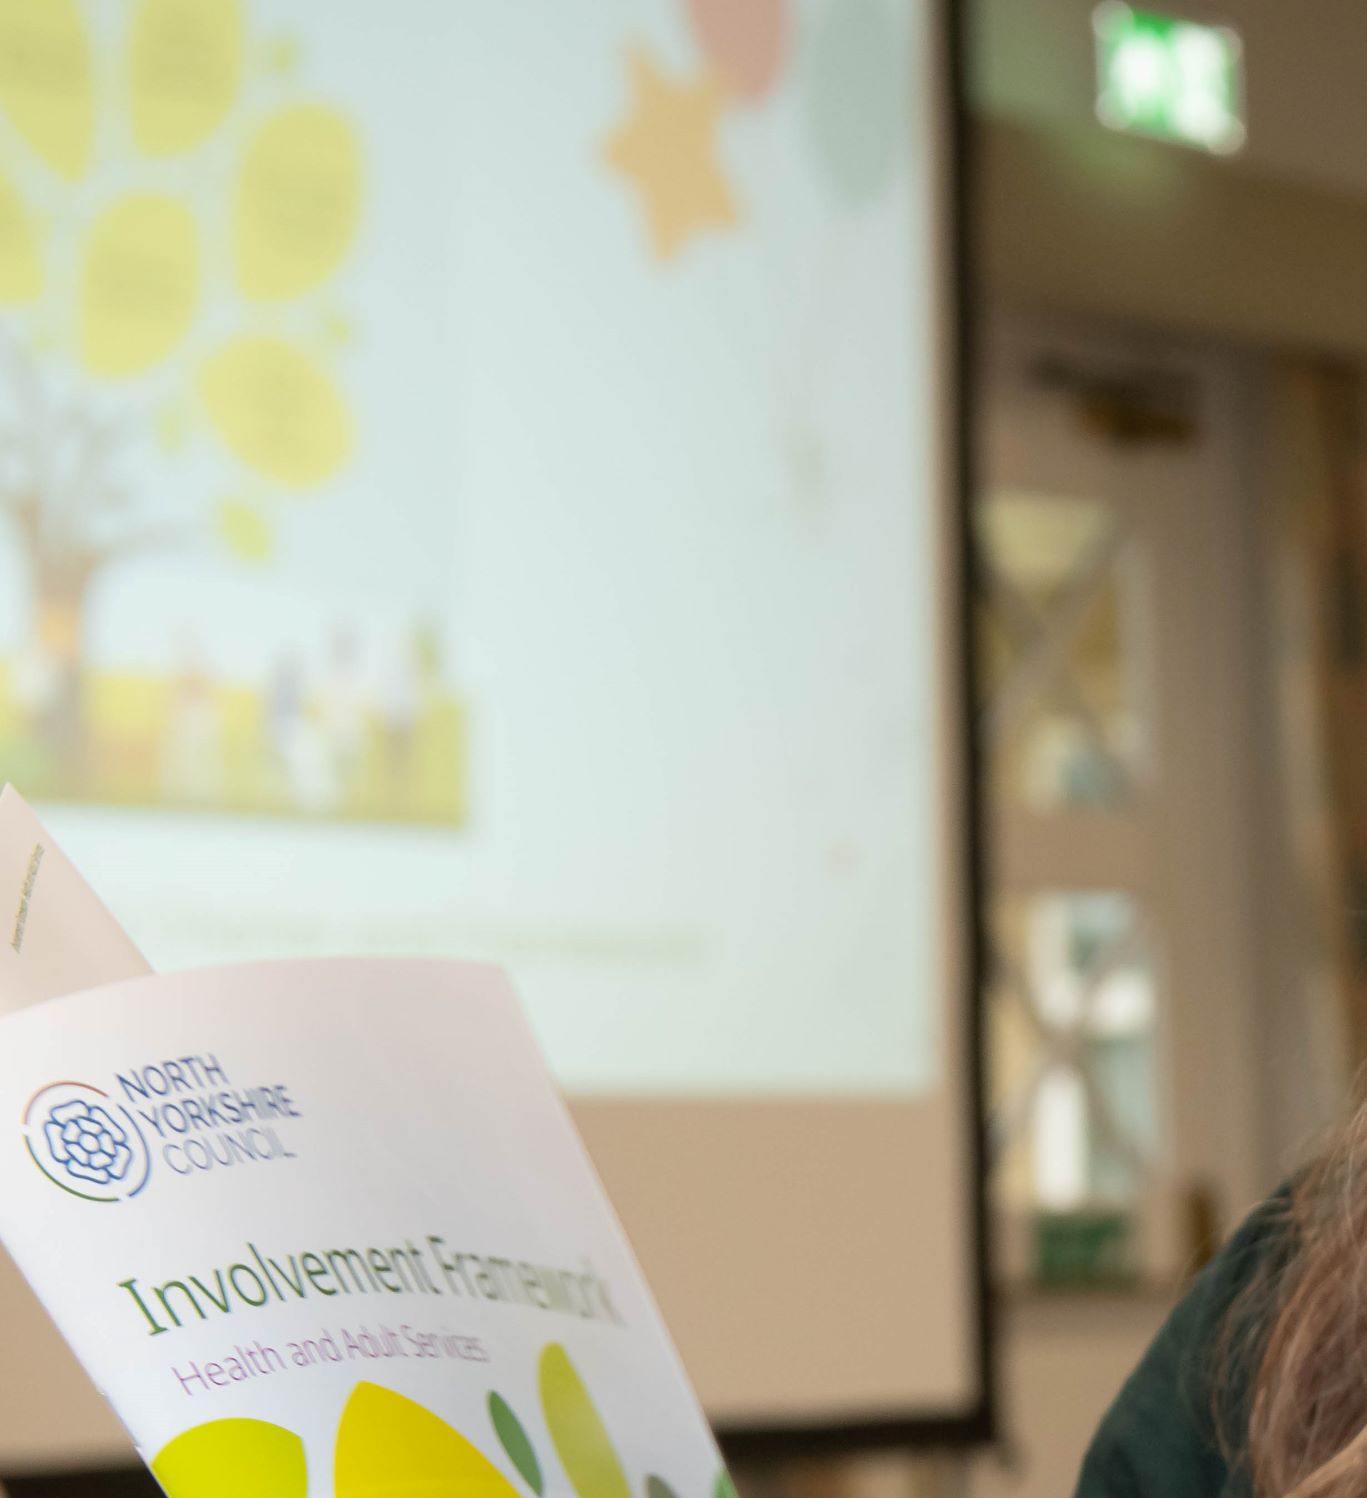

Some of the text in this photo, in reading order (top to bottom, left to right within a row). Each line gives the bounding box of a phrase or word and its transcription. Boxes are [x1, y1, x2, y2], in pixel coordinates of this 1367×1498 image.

[115, 1053, 230, 1102] NORTH
[137, 1084, 302, 1138] YORKSHIRE
[162, 1127, 297, 1174] COUNCIL
[119, 1236, 628, 1336] Involvement Framework
[171, 1325, 490, 1396] Health and Adult Services
